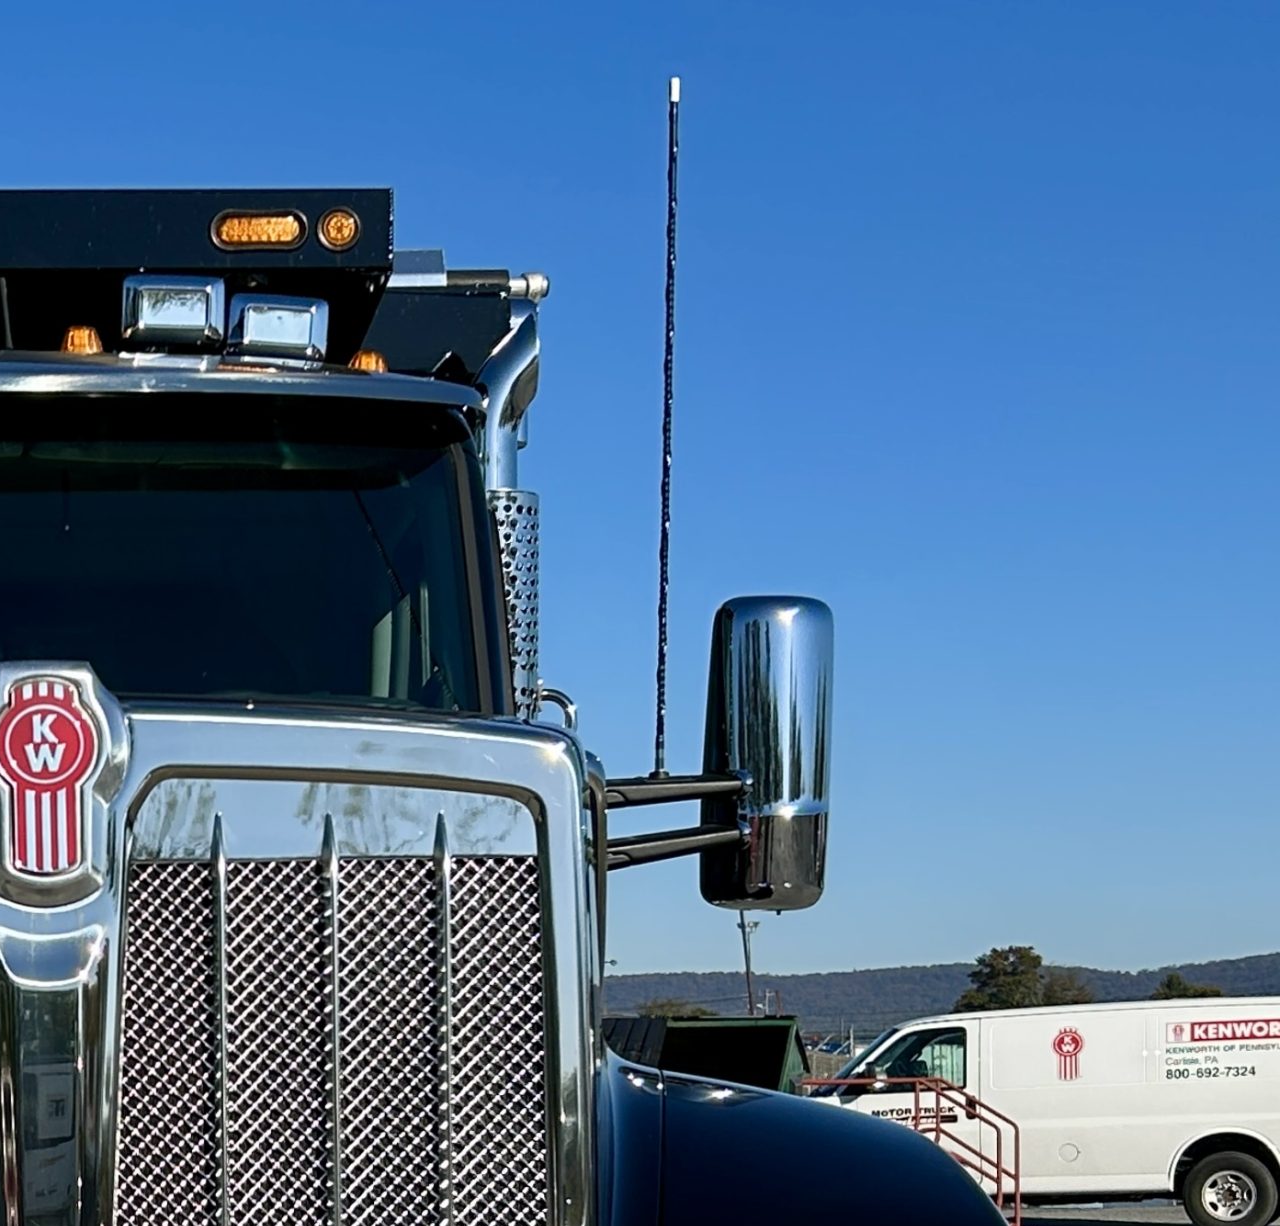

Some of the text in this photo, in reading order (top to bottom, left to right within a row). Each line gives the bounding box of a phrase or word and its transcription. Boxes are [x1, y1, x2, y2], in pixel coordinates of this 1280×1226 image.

[1166, 1044, 1220, 1054] KENWORTH
[1223, 1043, 1235, 1052] OF
[1204, 1054, 1218, 1064] PA
[1166, 1065, 1256, 1079] 800-692-7324
[871, 1108, 912, 1117] MOTOR
